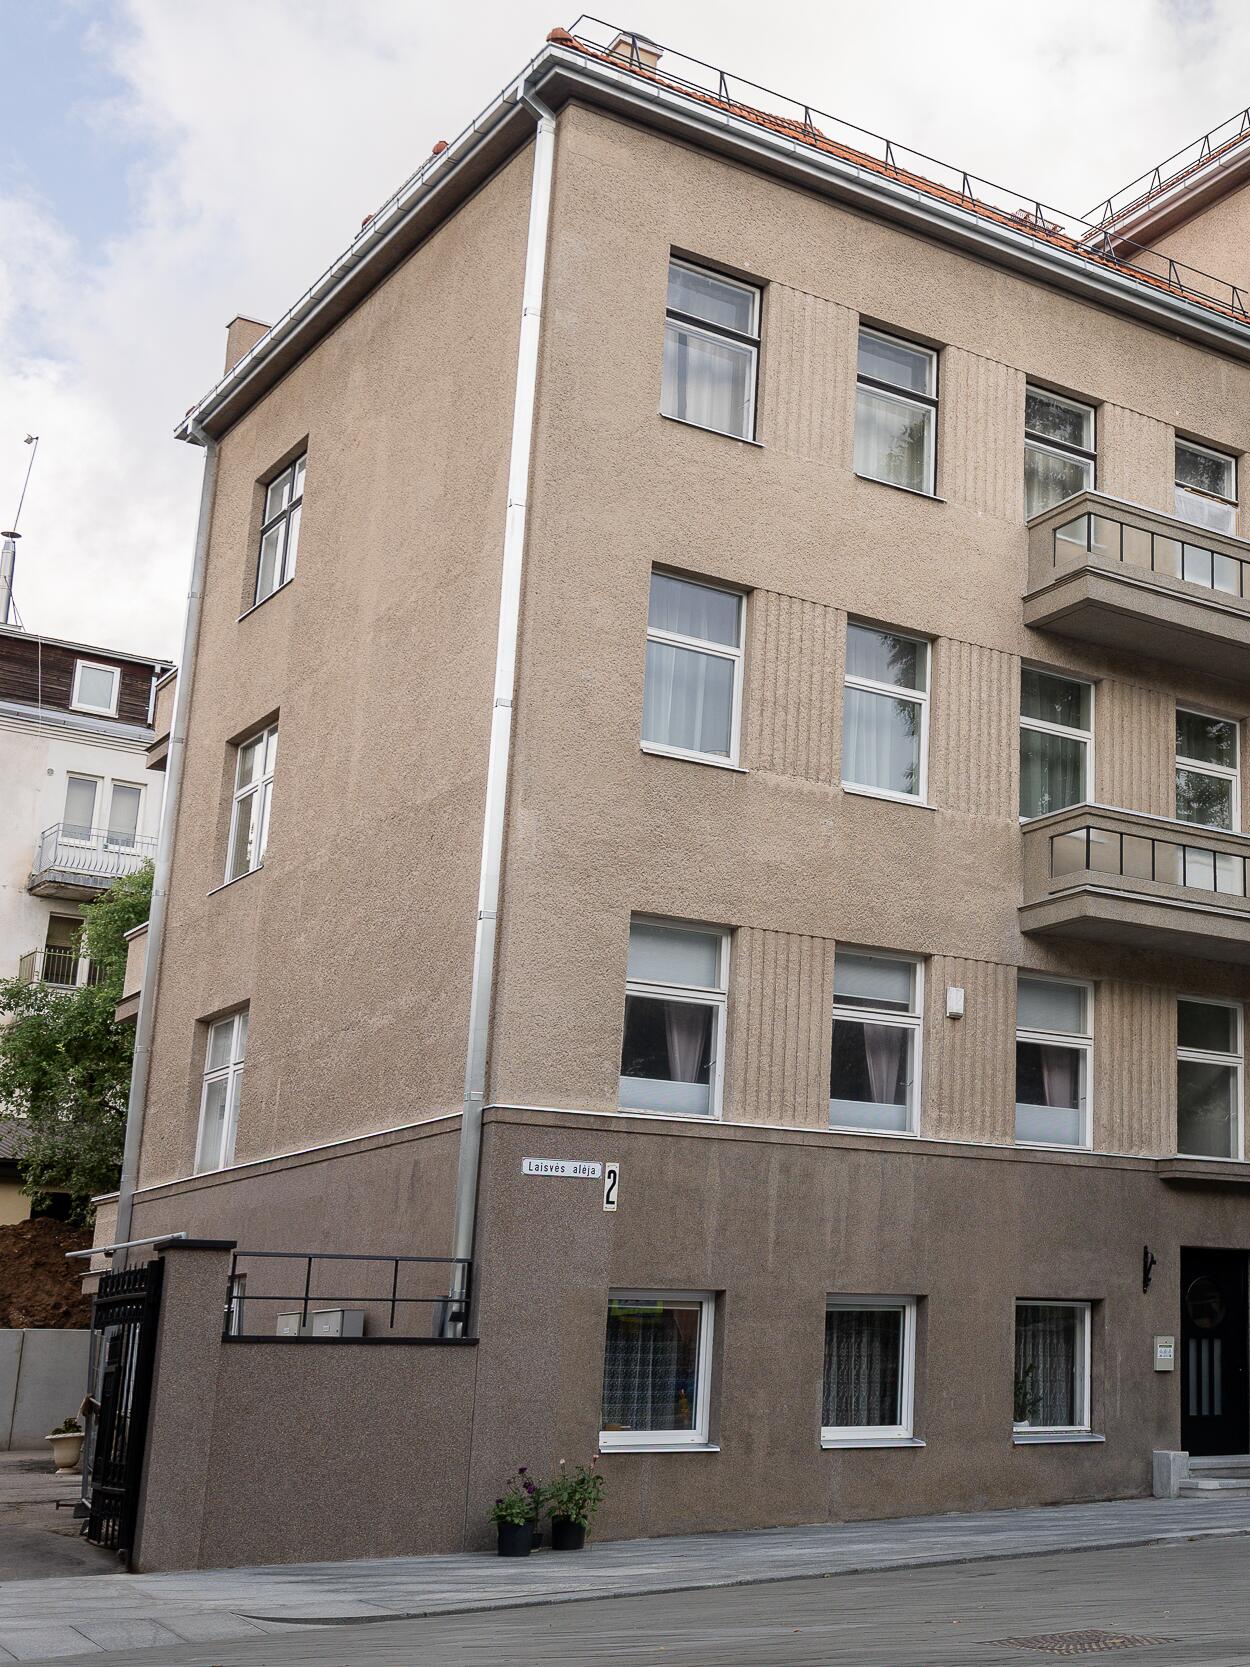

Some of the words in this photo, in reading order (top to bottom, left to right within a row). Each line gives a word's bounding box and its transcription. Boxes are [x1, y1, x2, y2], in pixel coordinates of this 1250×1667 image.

[528, 1161, 565, 1173] Laisvės
[573, 1163, 596, 1176] alėja
[606, 1169, 617, 1205] 2
